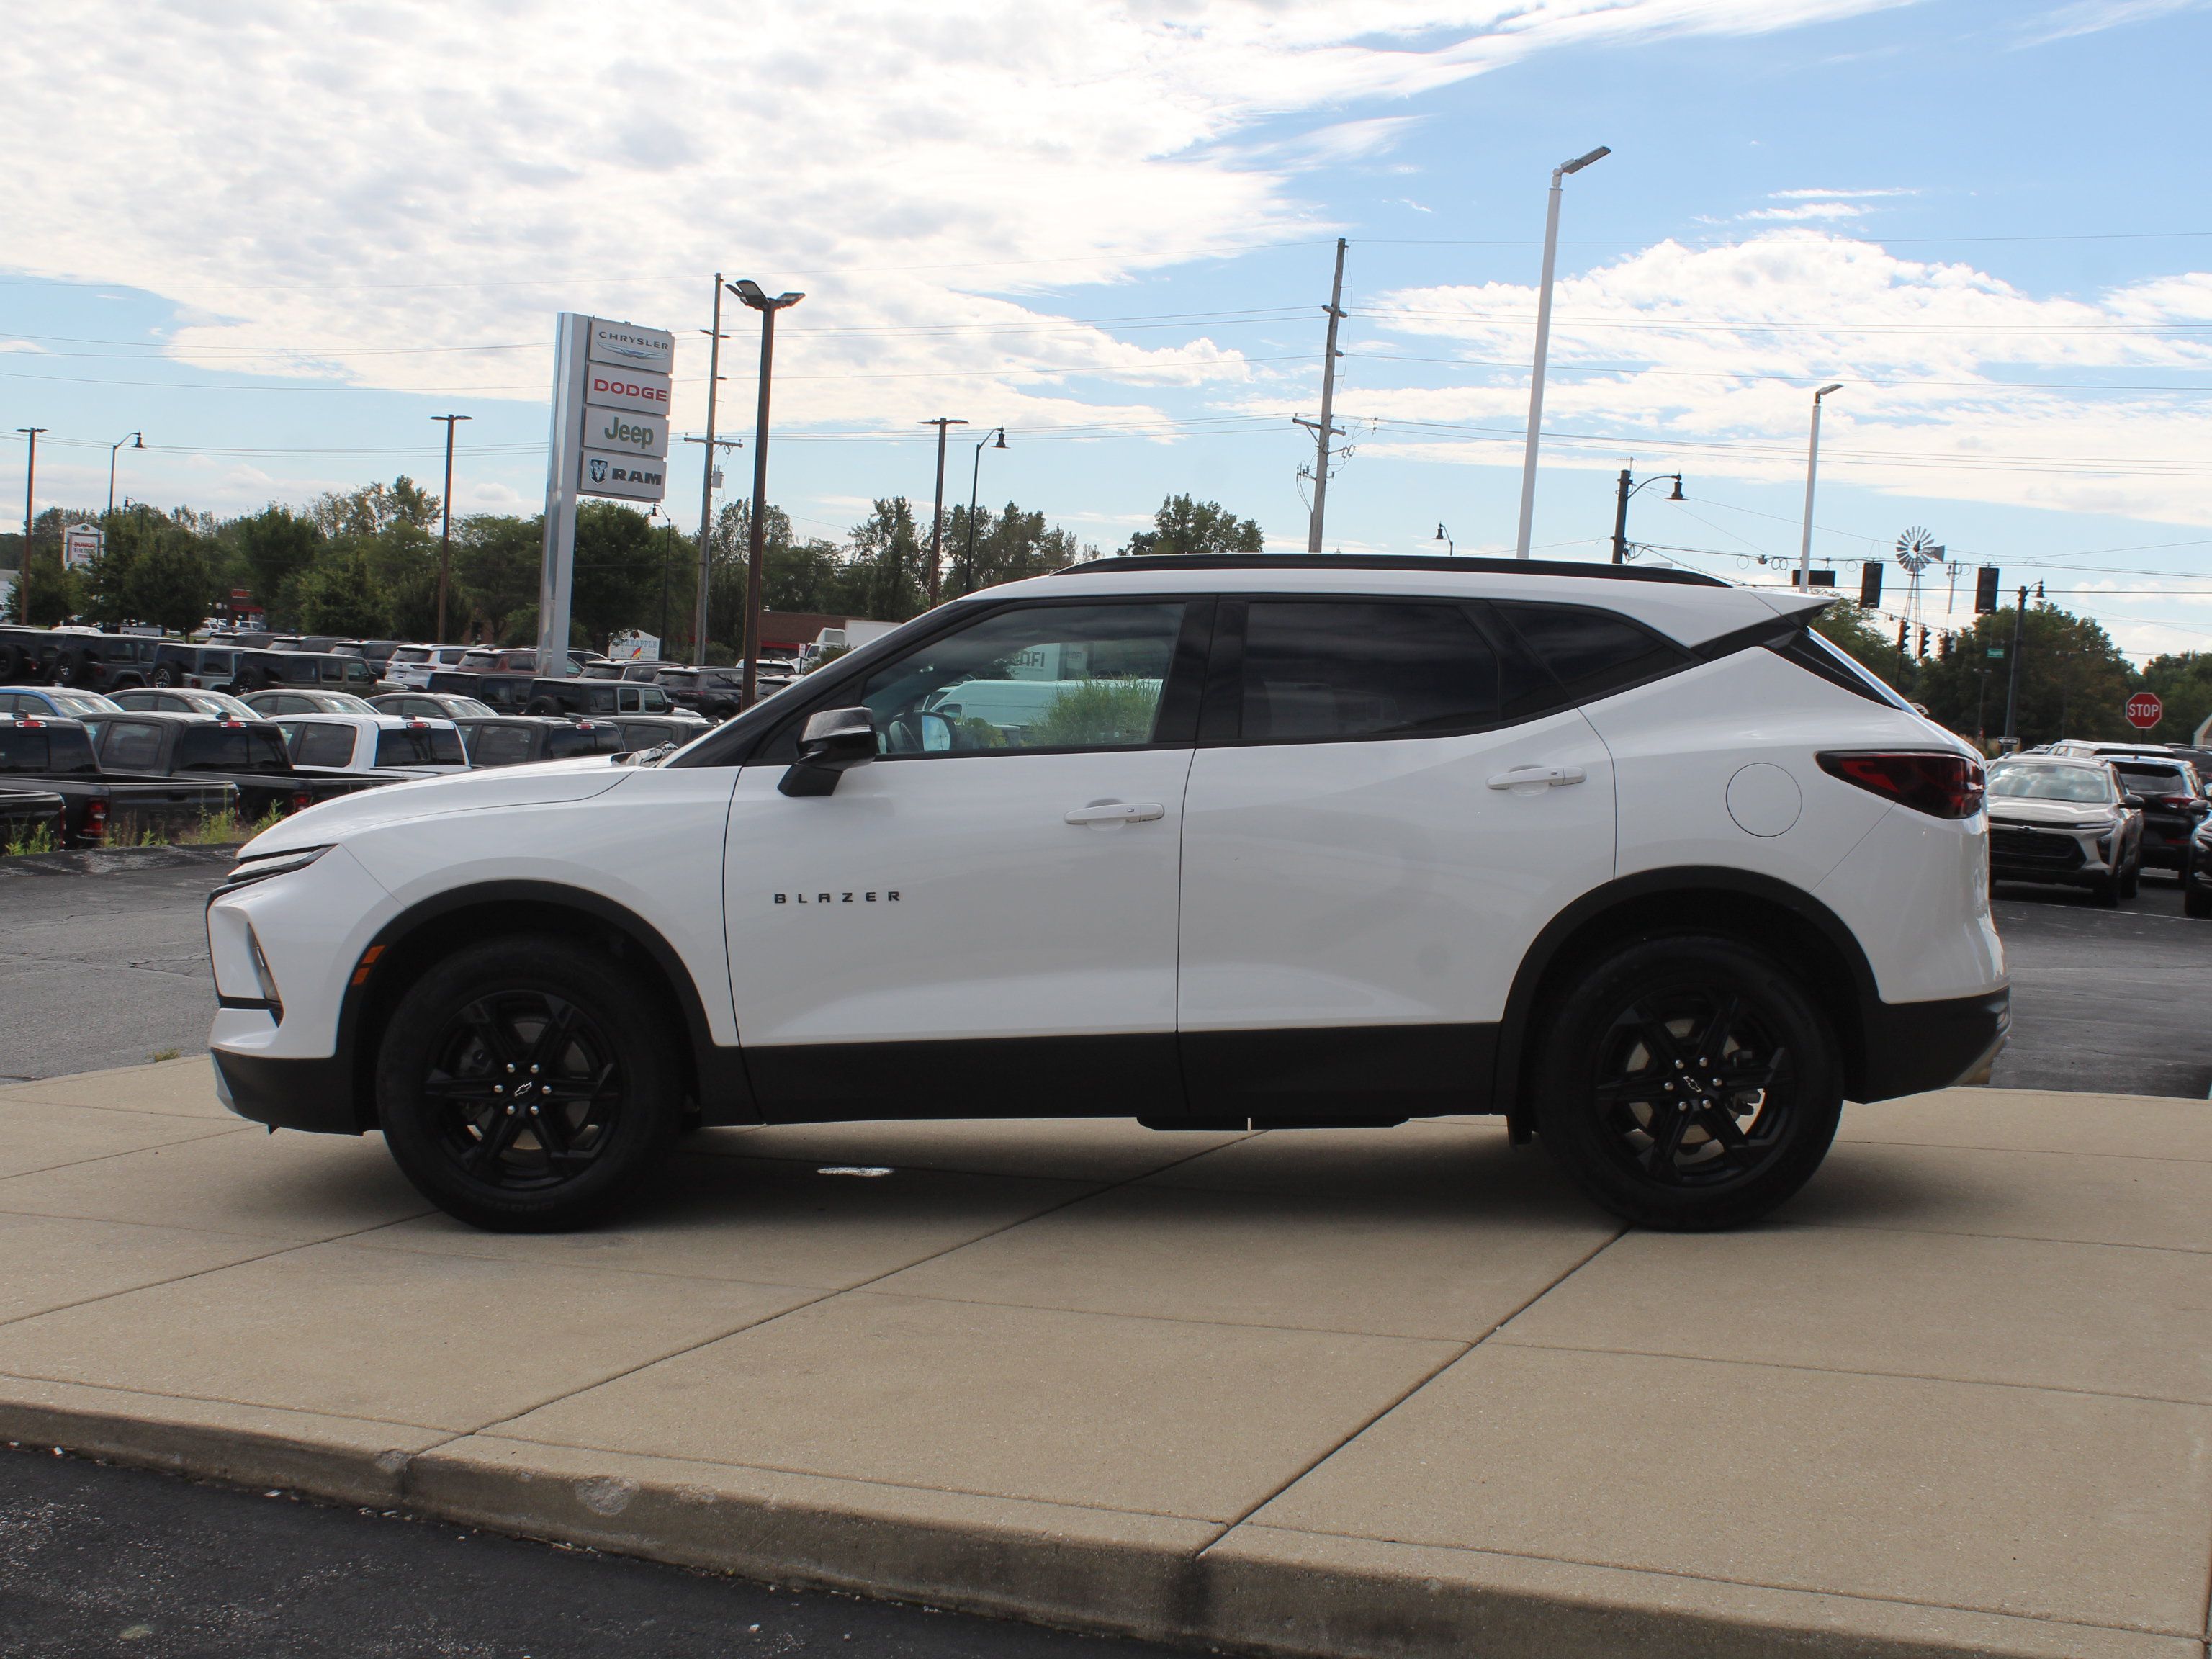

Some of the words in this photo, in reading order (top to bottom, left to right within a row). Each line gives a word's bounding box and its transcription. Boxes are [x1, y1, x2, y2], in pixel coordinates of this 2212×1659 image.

[598, 331, 669, 350] CHRYSLER
[593, 378, 667, 402] DODGE
[604, 417, 654, 449] Jeep
[612, 468, 662, 486] RAM
[1014, 650, 1045, 667] NFI
[2128, 703, 2159, 716] STOP
[774, 891, 900, 904] BLAZER
